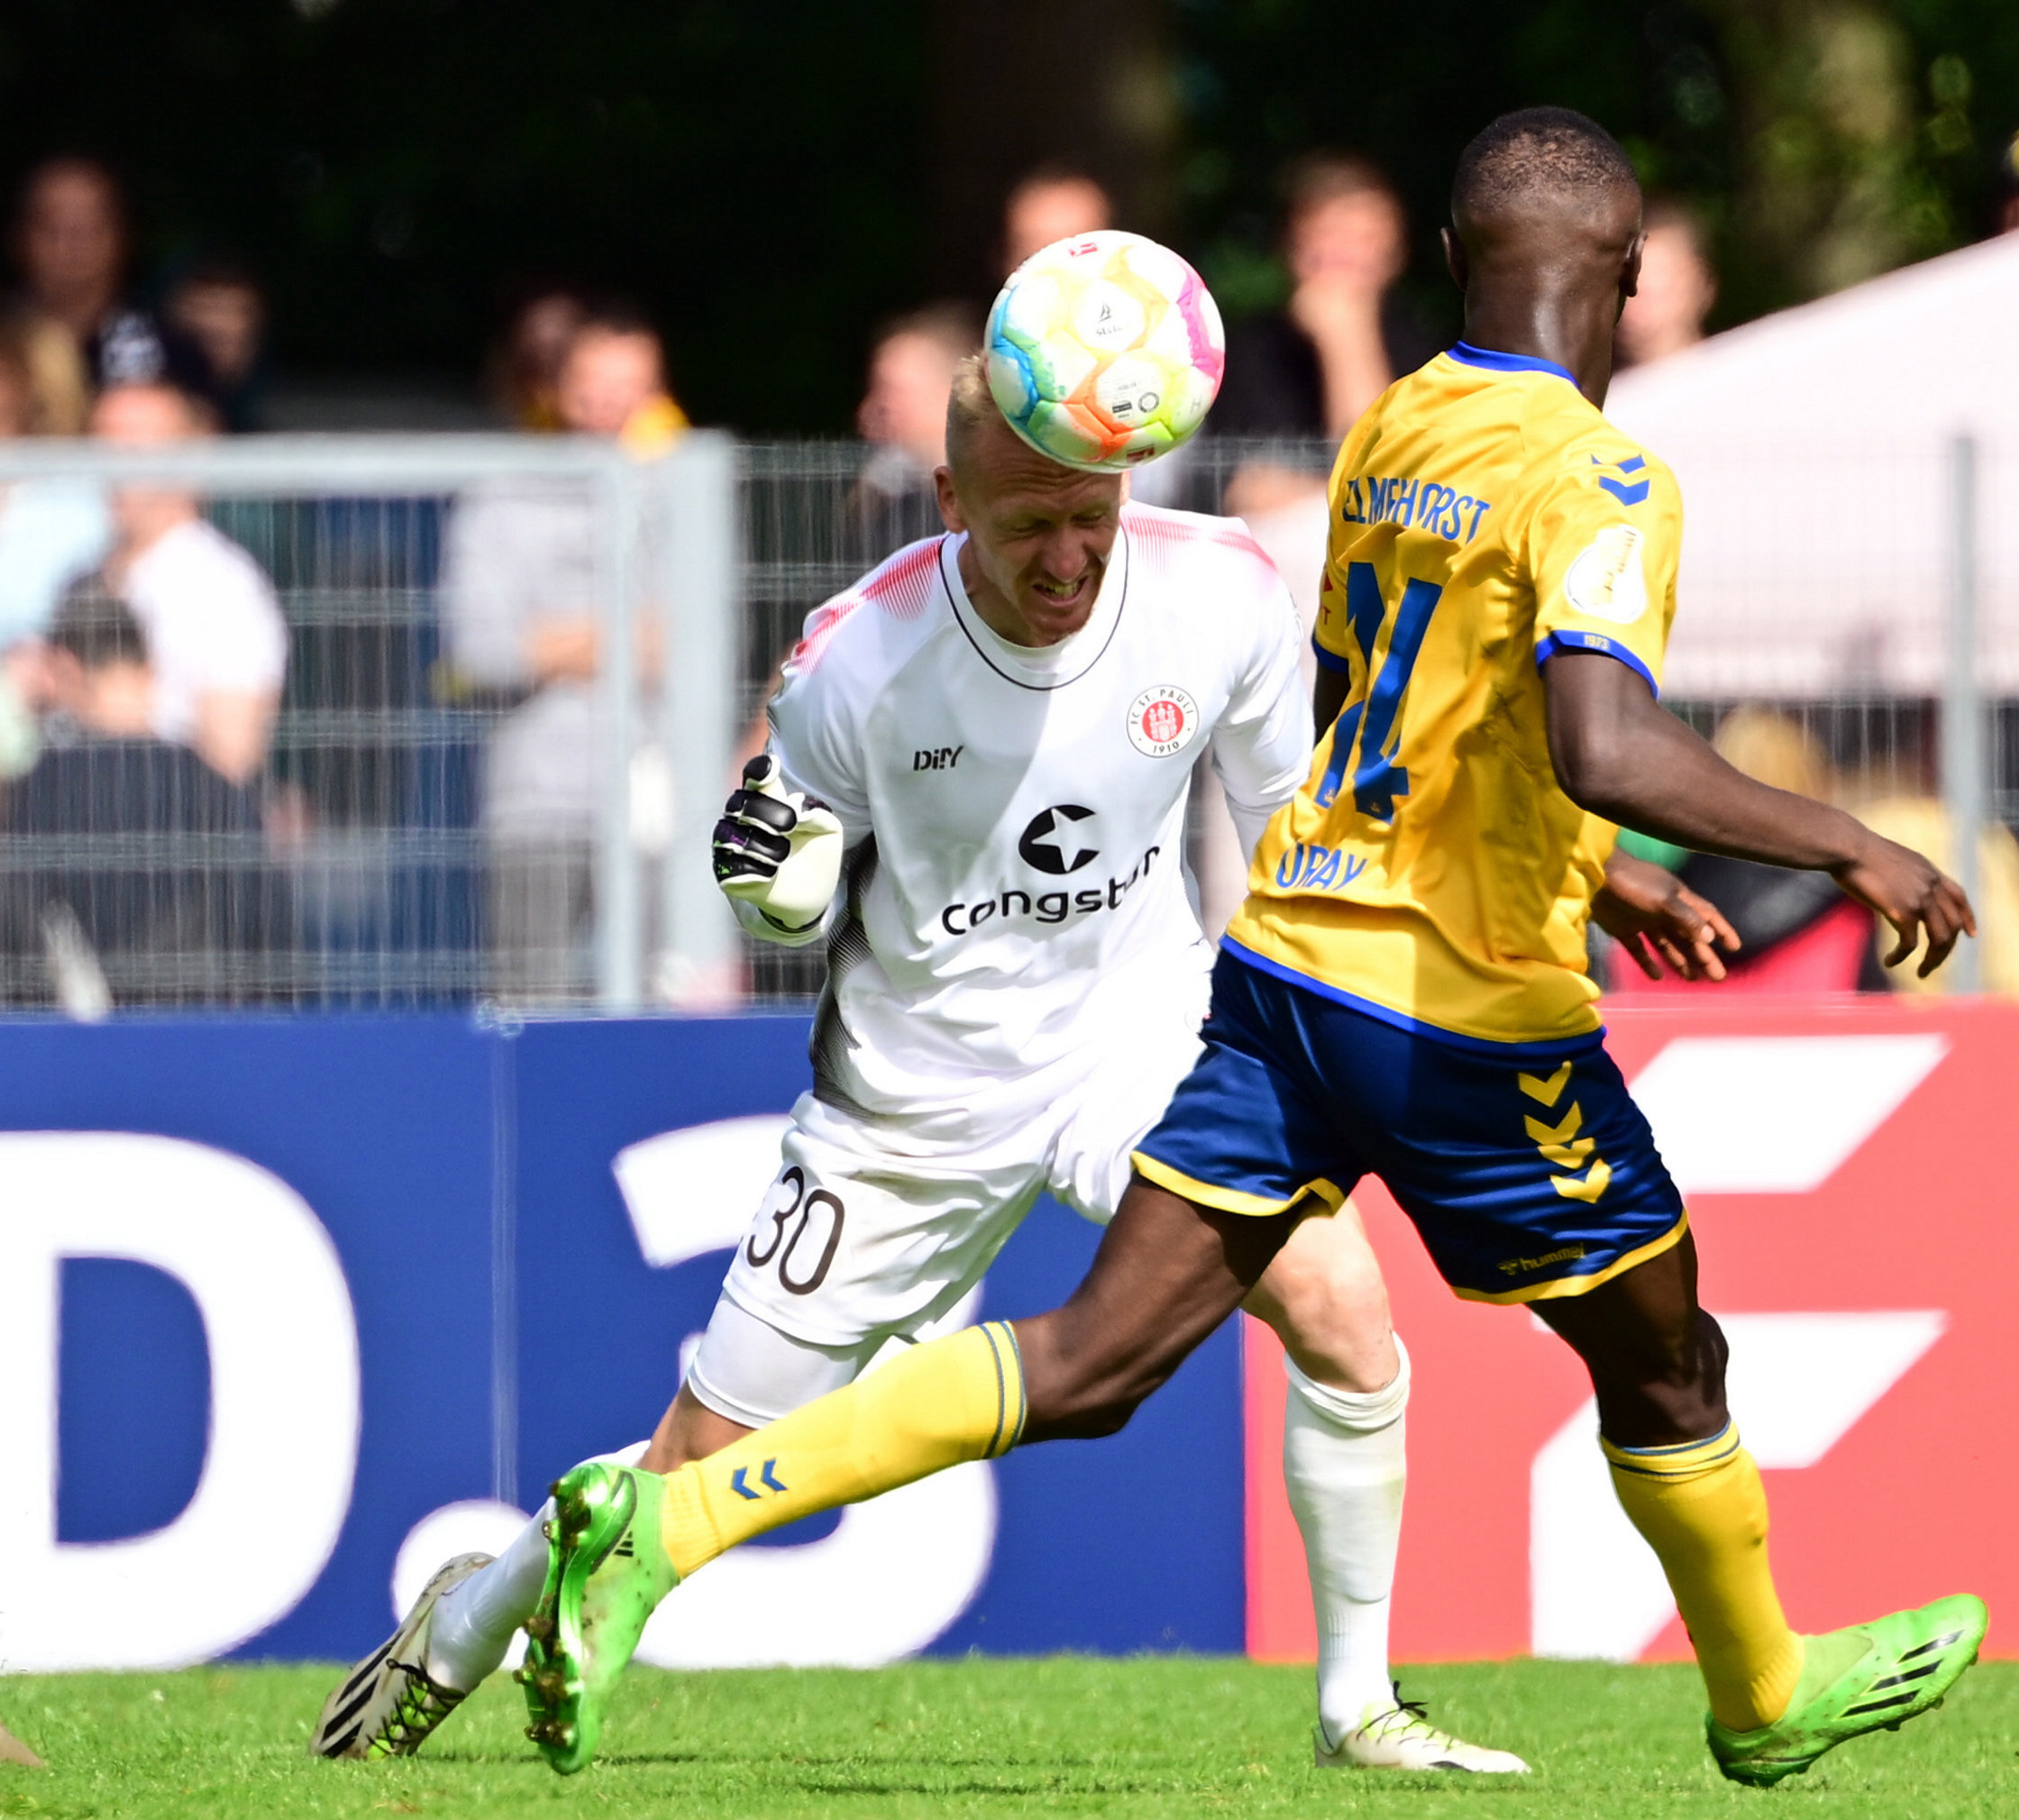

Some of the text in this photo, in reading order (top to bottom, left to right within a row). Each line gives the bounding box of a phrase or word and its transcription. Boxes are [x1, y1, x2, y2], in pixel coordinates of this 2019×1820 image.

[1159, 689, 1194, 714] PAULI
[1153, 741, 1180, 754] 1910
[746, 1166, 845, 1295] 30
[1520, 1242, 1585, 1271] hummel
